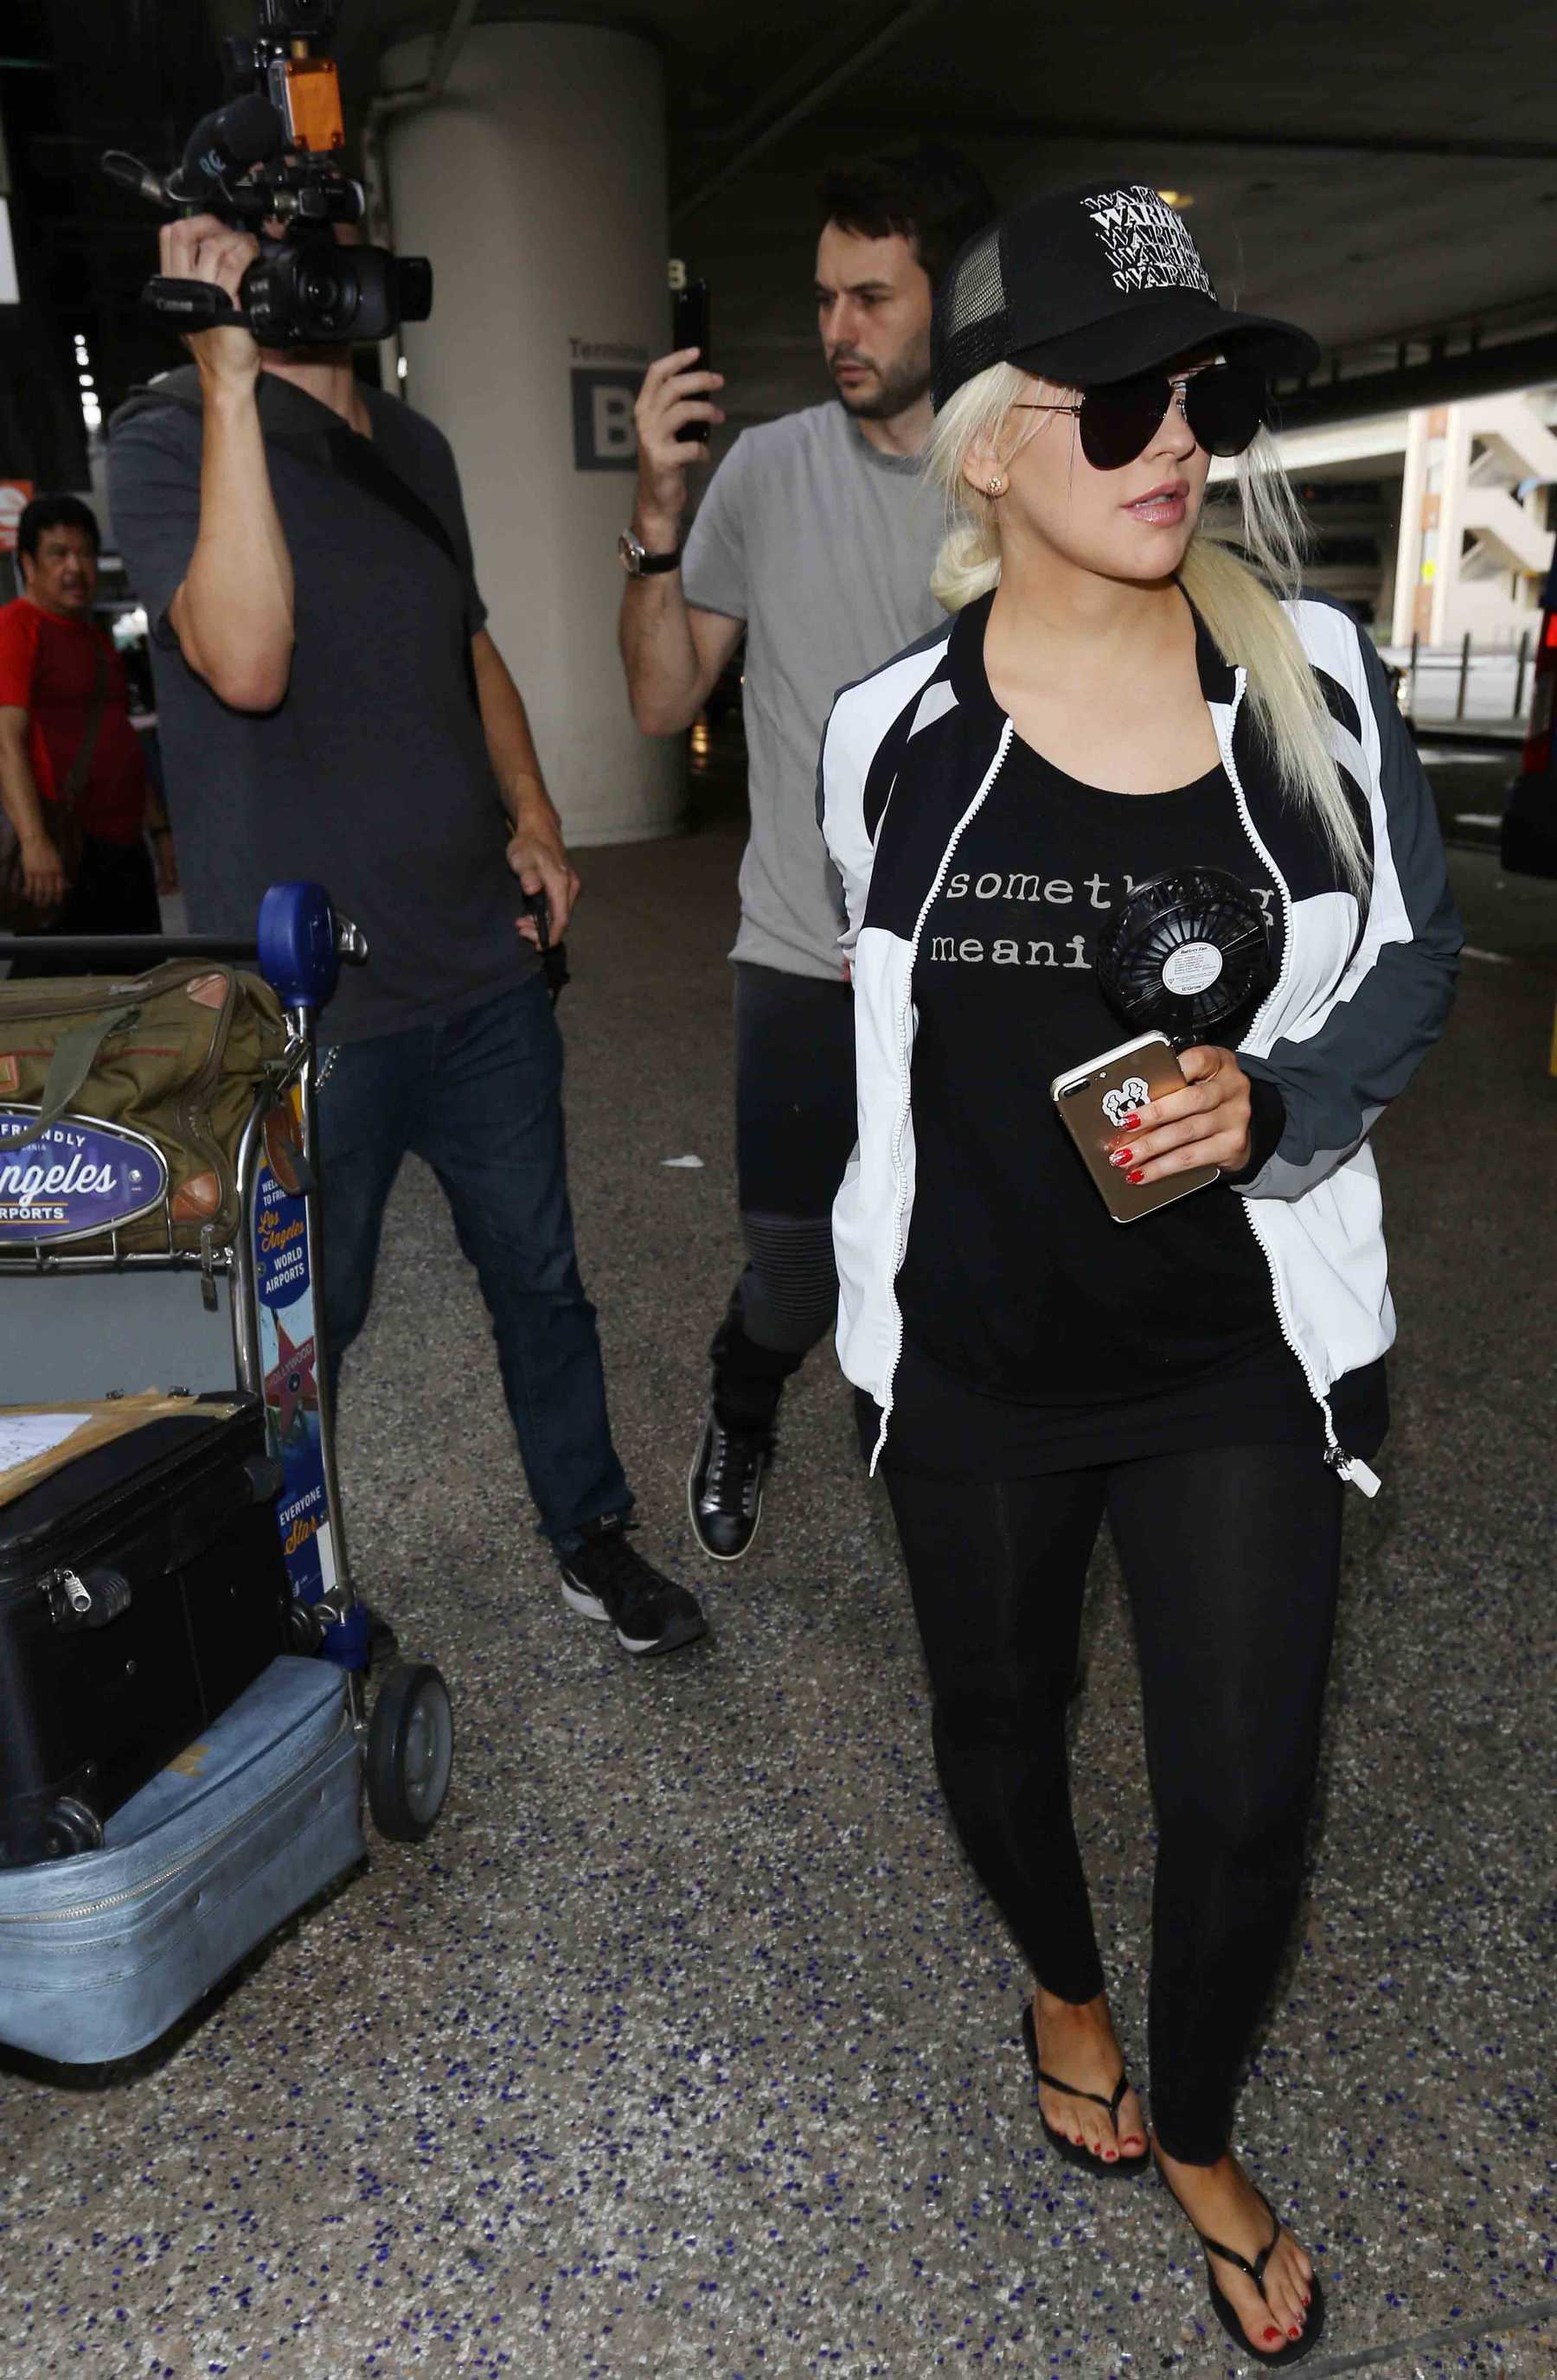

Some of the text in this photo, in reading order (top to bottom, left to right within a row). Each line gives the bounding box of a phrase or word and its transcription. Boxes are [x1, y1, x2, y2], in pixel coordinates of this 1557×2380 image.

[668, 259, 686, 290] B
[593, 386, 638, 457] B
[930, 935, 1092, 969] meani
[1, 1123, 86, 1148] FRNDLY
[264, 1194, 272, 1206] TO
[259, 1210, 279, 1235] Los
[261, 1220, 305, 1252] Angeles
[274, 1246, 303, 1271] WORLD
[266, 1263, 304, 1295] AIRPORTS
[279, 1486, 322, 1527] EVERYONE
[284, 1514, 317, 1555] Star
